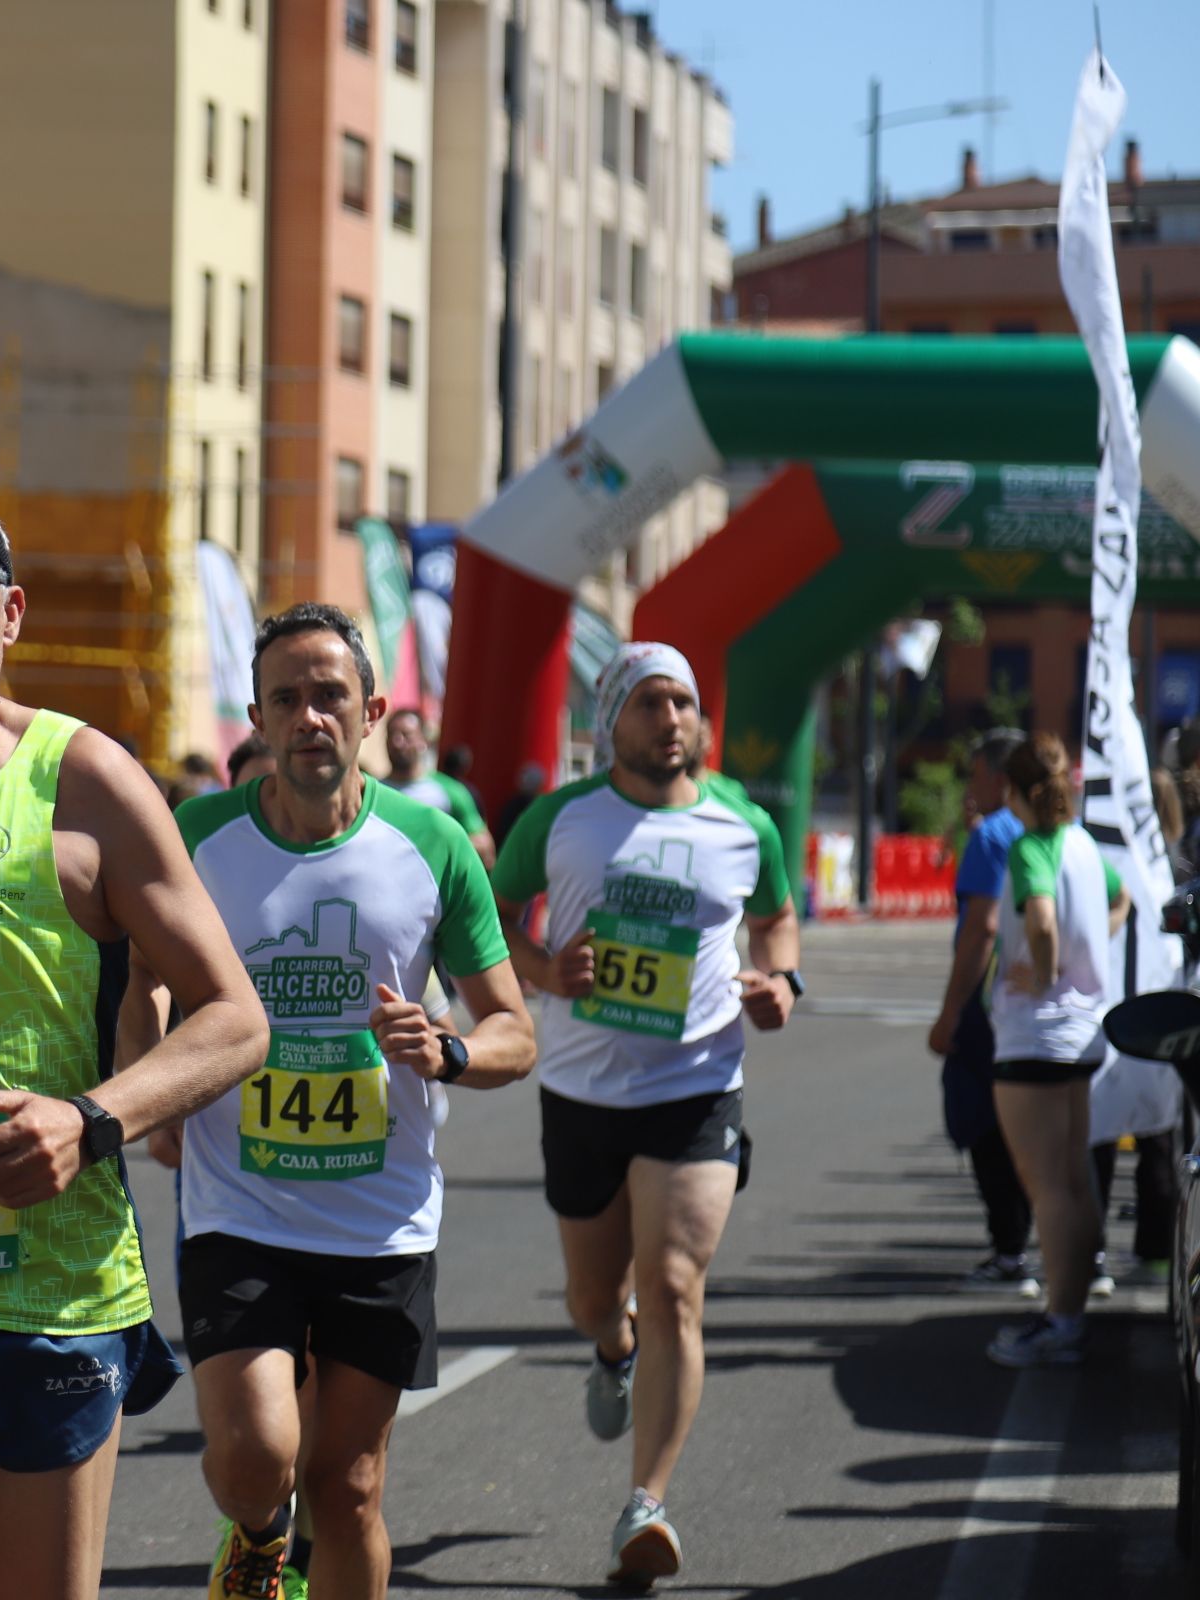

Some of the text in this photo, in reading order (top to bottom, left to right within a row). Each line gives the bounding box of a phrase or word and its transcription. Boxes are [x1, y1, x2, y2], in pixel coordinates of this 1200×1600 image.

[275, 960, 340, 972] IX CARRERA
[600, 948, 660, 998] 55
[256, 972, 362, 998] EL CERCO
[277, 1001, 338, 1014] DE ZAMORA
[279, 1052, 307, 1064] CAJA
[251, 1073, 359, 1134] 144
[279, 1151, 378, 1169] CAJA RURAL
